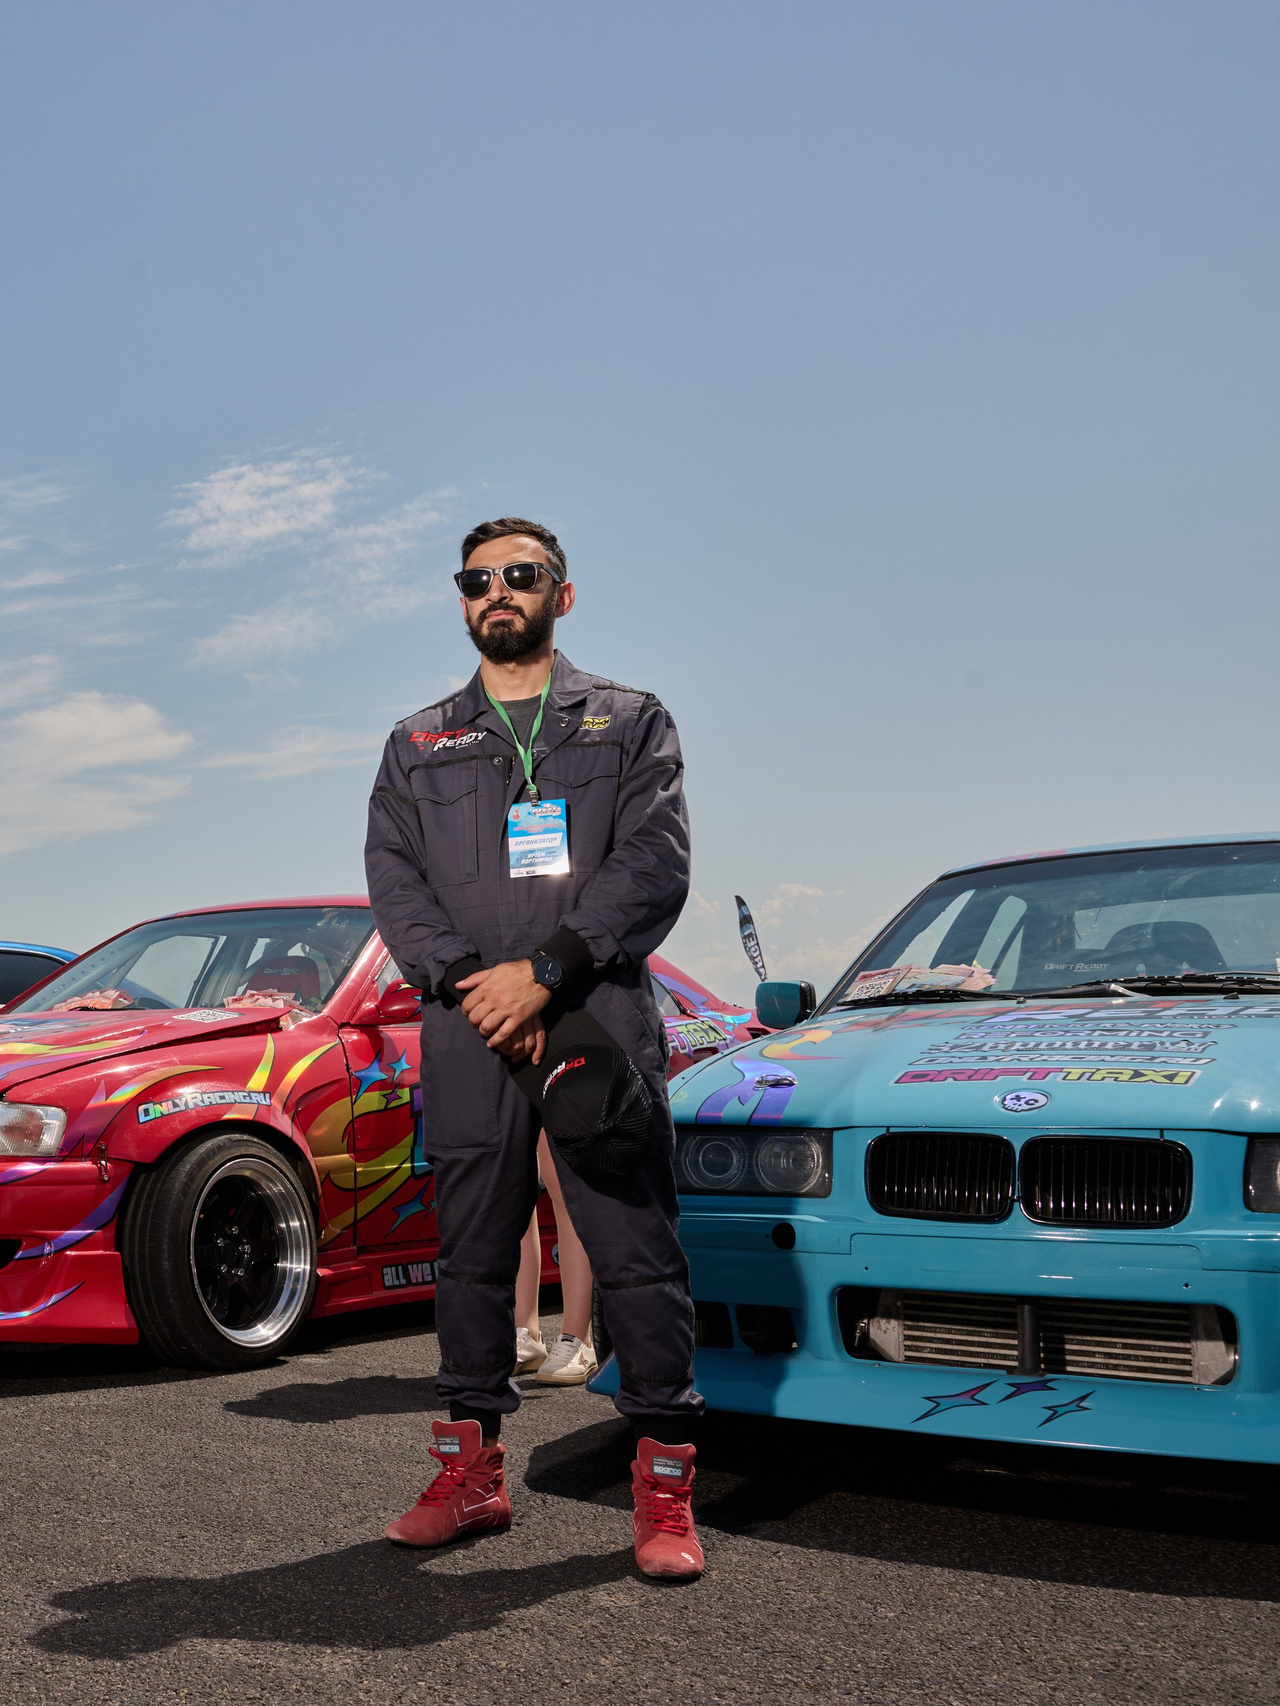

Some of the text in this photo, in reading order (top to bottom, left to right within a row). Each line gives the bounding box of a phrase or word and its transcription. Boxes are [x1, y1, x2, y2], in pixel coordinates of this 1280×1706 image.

[581, 716, 610, 729] AXI
[409, 728, 465, 743] DRIFT
[433, 731, 487, 752] READY
[514, 837, 558, 847] ОРГАНИЗАТОР
